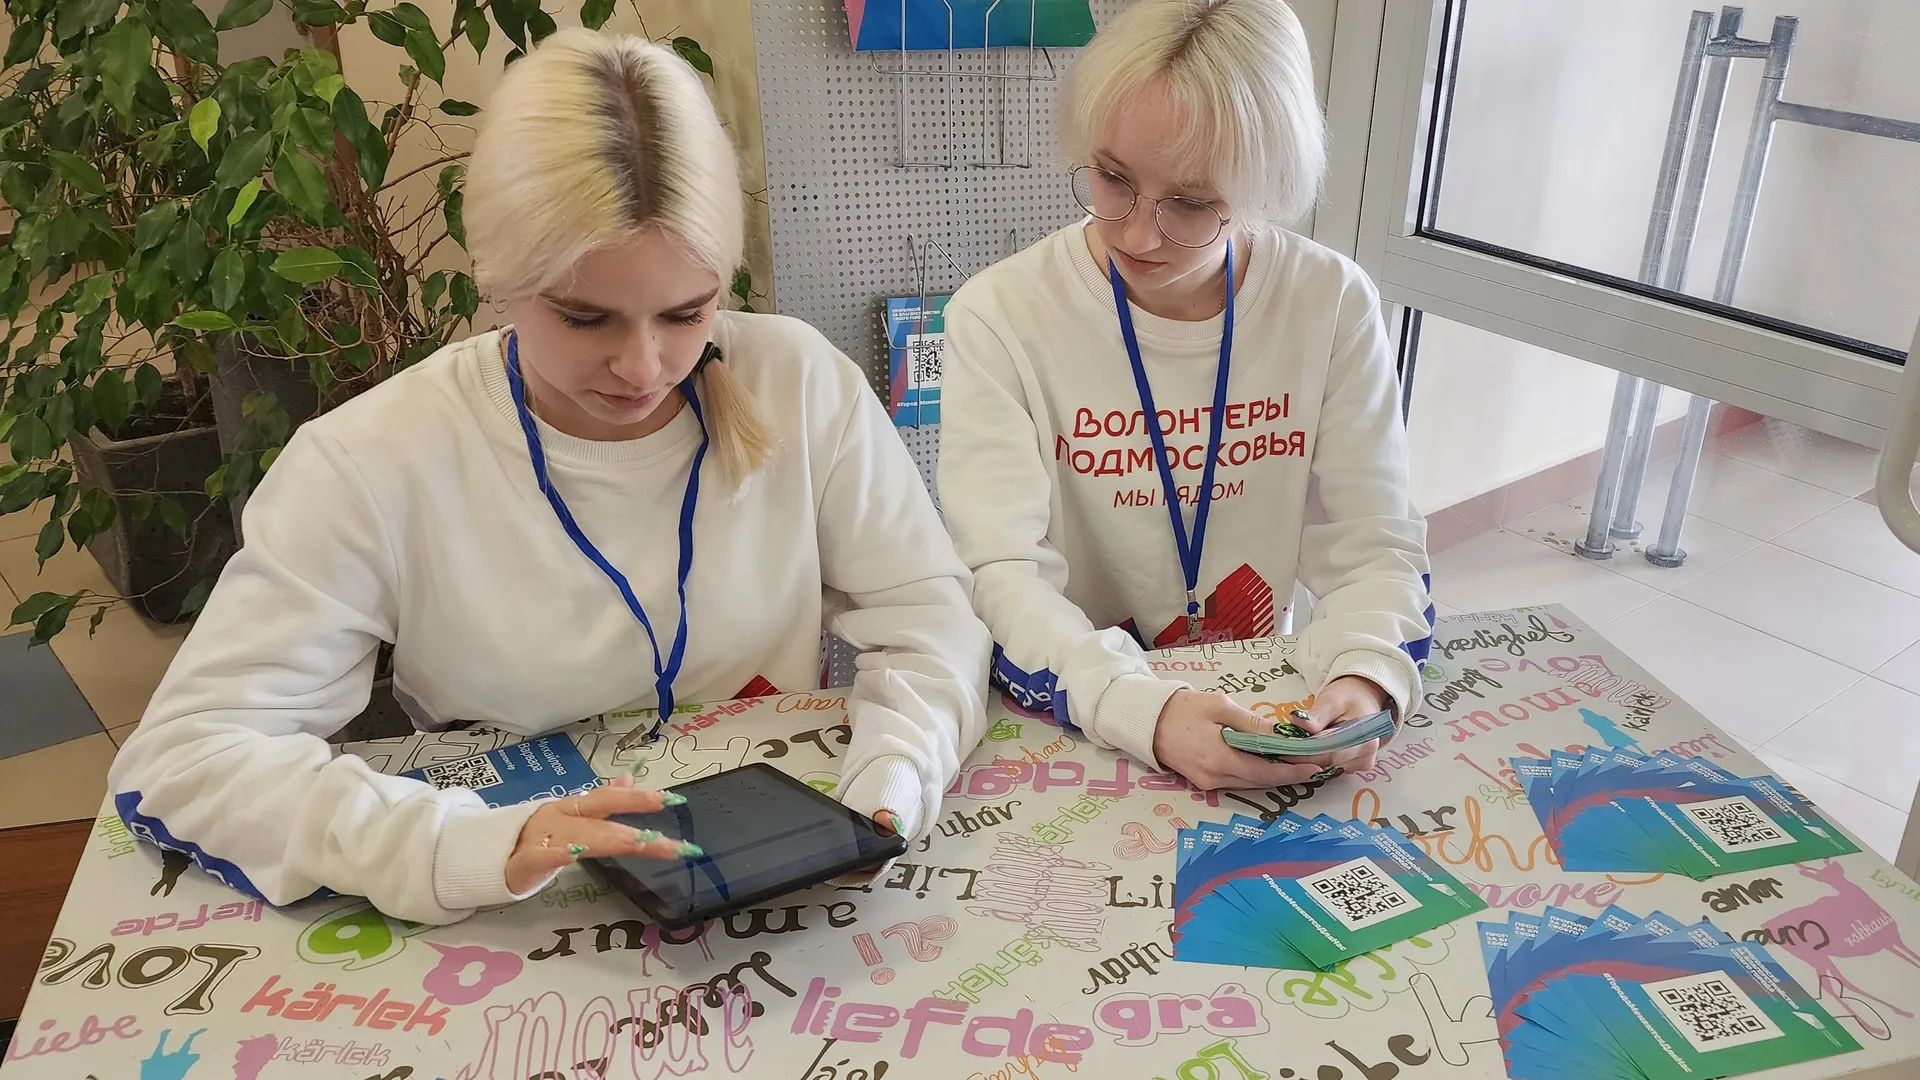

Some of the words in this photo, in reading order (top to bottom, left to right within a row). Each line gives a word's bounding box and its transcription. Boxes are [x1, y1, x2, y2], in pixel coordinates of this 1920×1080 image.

[1113, 489, 1155, 508] МЫ
[671, 696, 765, 735] kärlek
[497, 749, 516, 771] волонтёр
[518, 742, 543, 773] Варвара
[536, 737, 566, 776] Михайлова
[111, 901, 262, 937] liefde
[240, 975, 452, 1036] kärlek
[790, 976, 1095, 1064] liefde
[1094, 982, 1269, 1046] grá
[271, 1036, 391, 1067] kärlek
